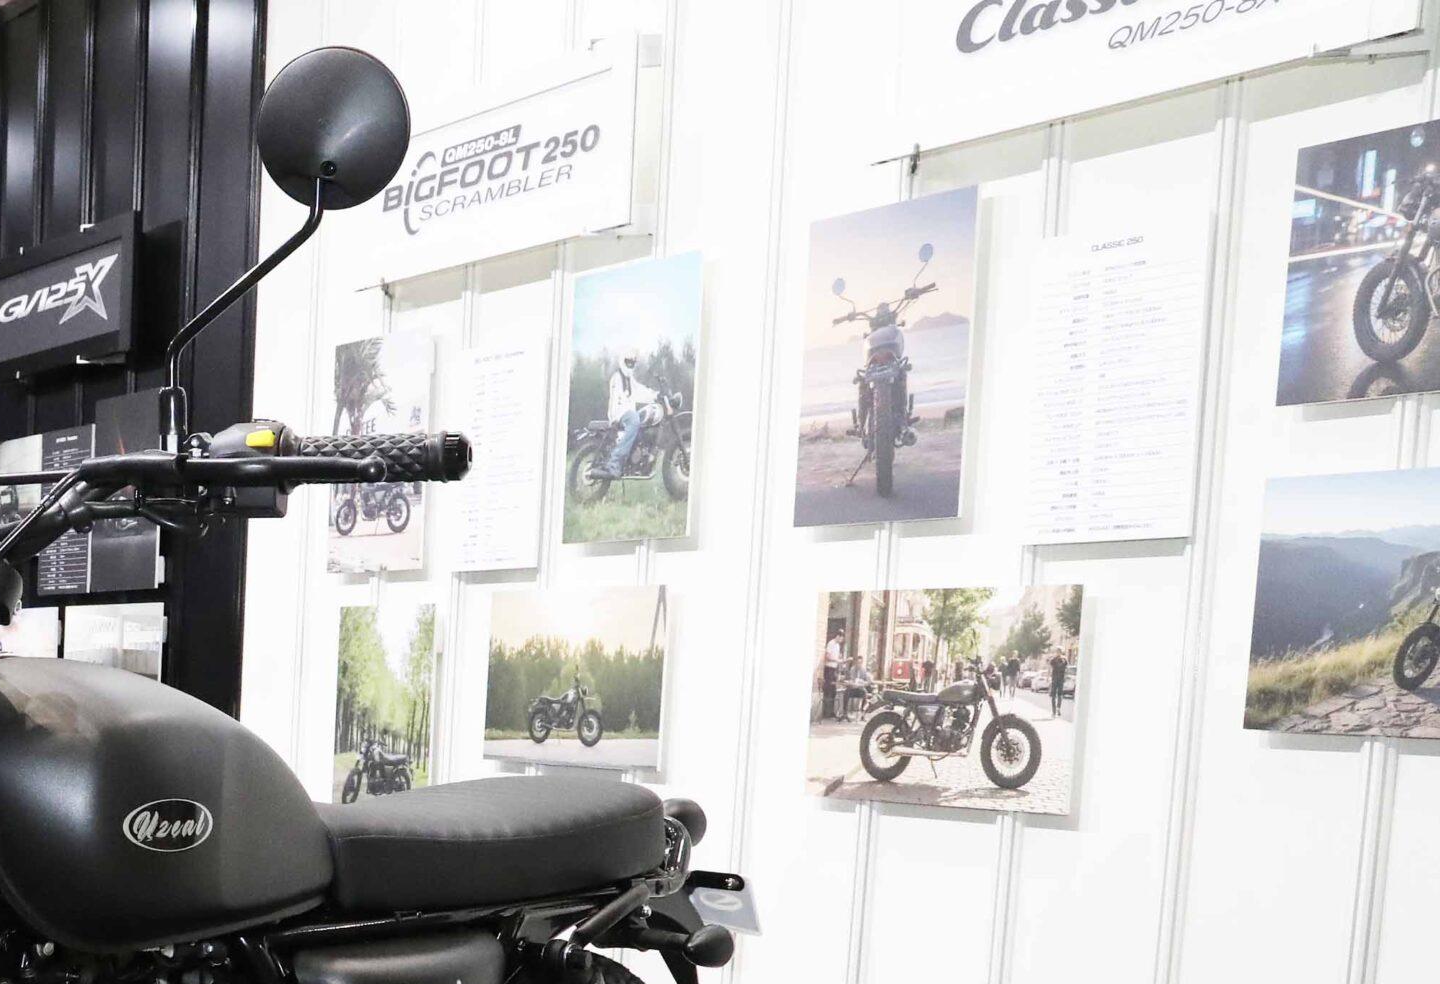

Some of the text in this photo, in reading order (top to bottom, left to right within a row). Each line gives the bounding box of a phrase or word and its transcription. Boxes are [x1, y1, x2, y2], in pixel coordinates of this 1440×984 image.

[418, 164, 574, 222] SCRAMBLER
[1091, 235, 1144, 253] CLASSIC 250
